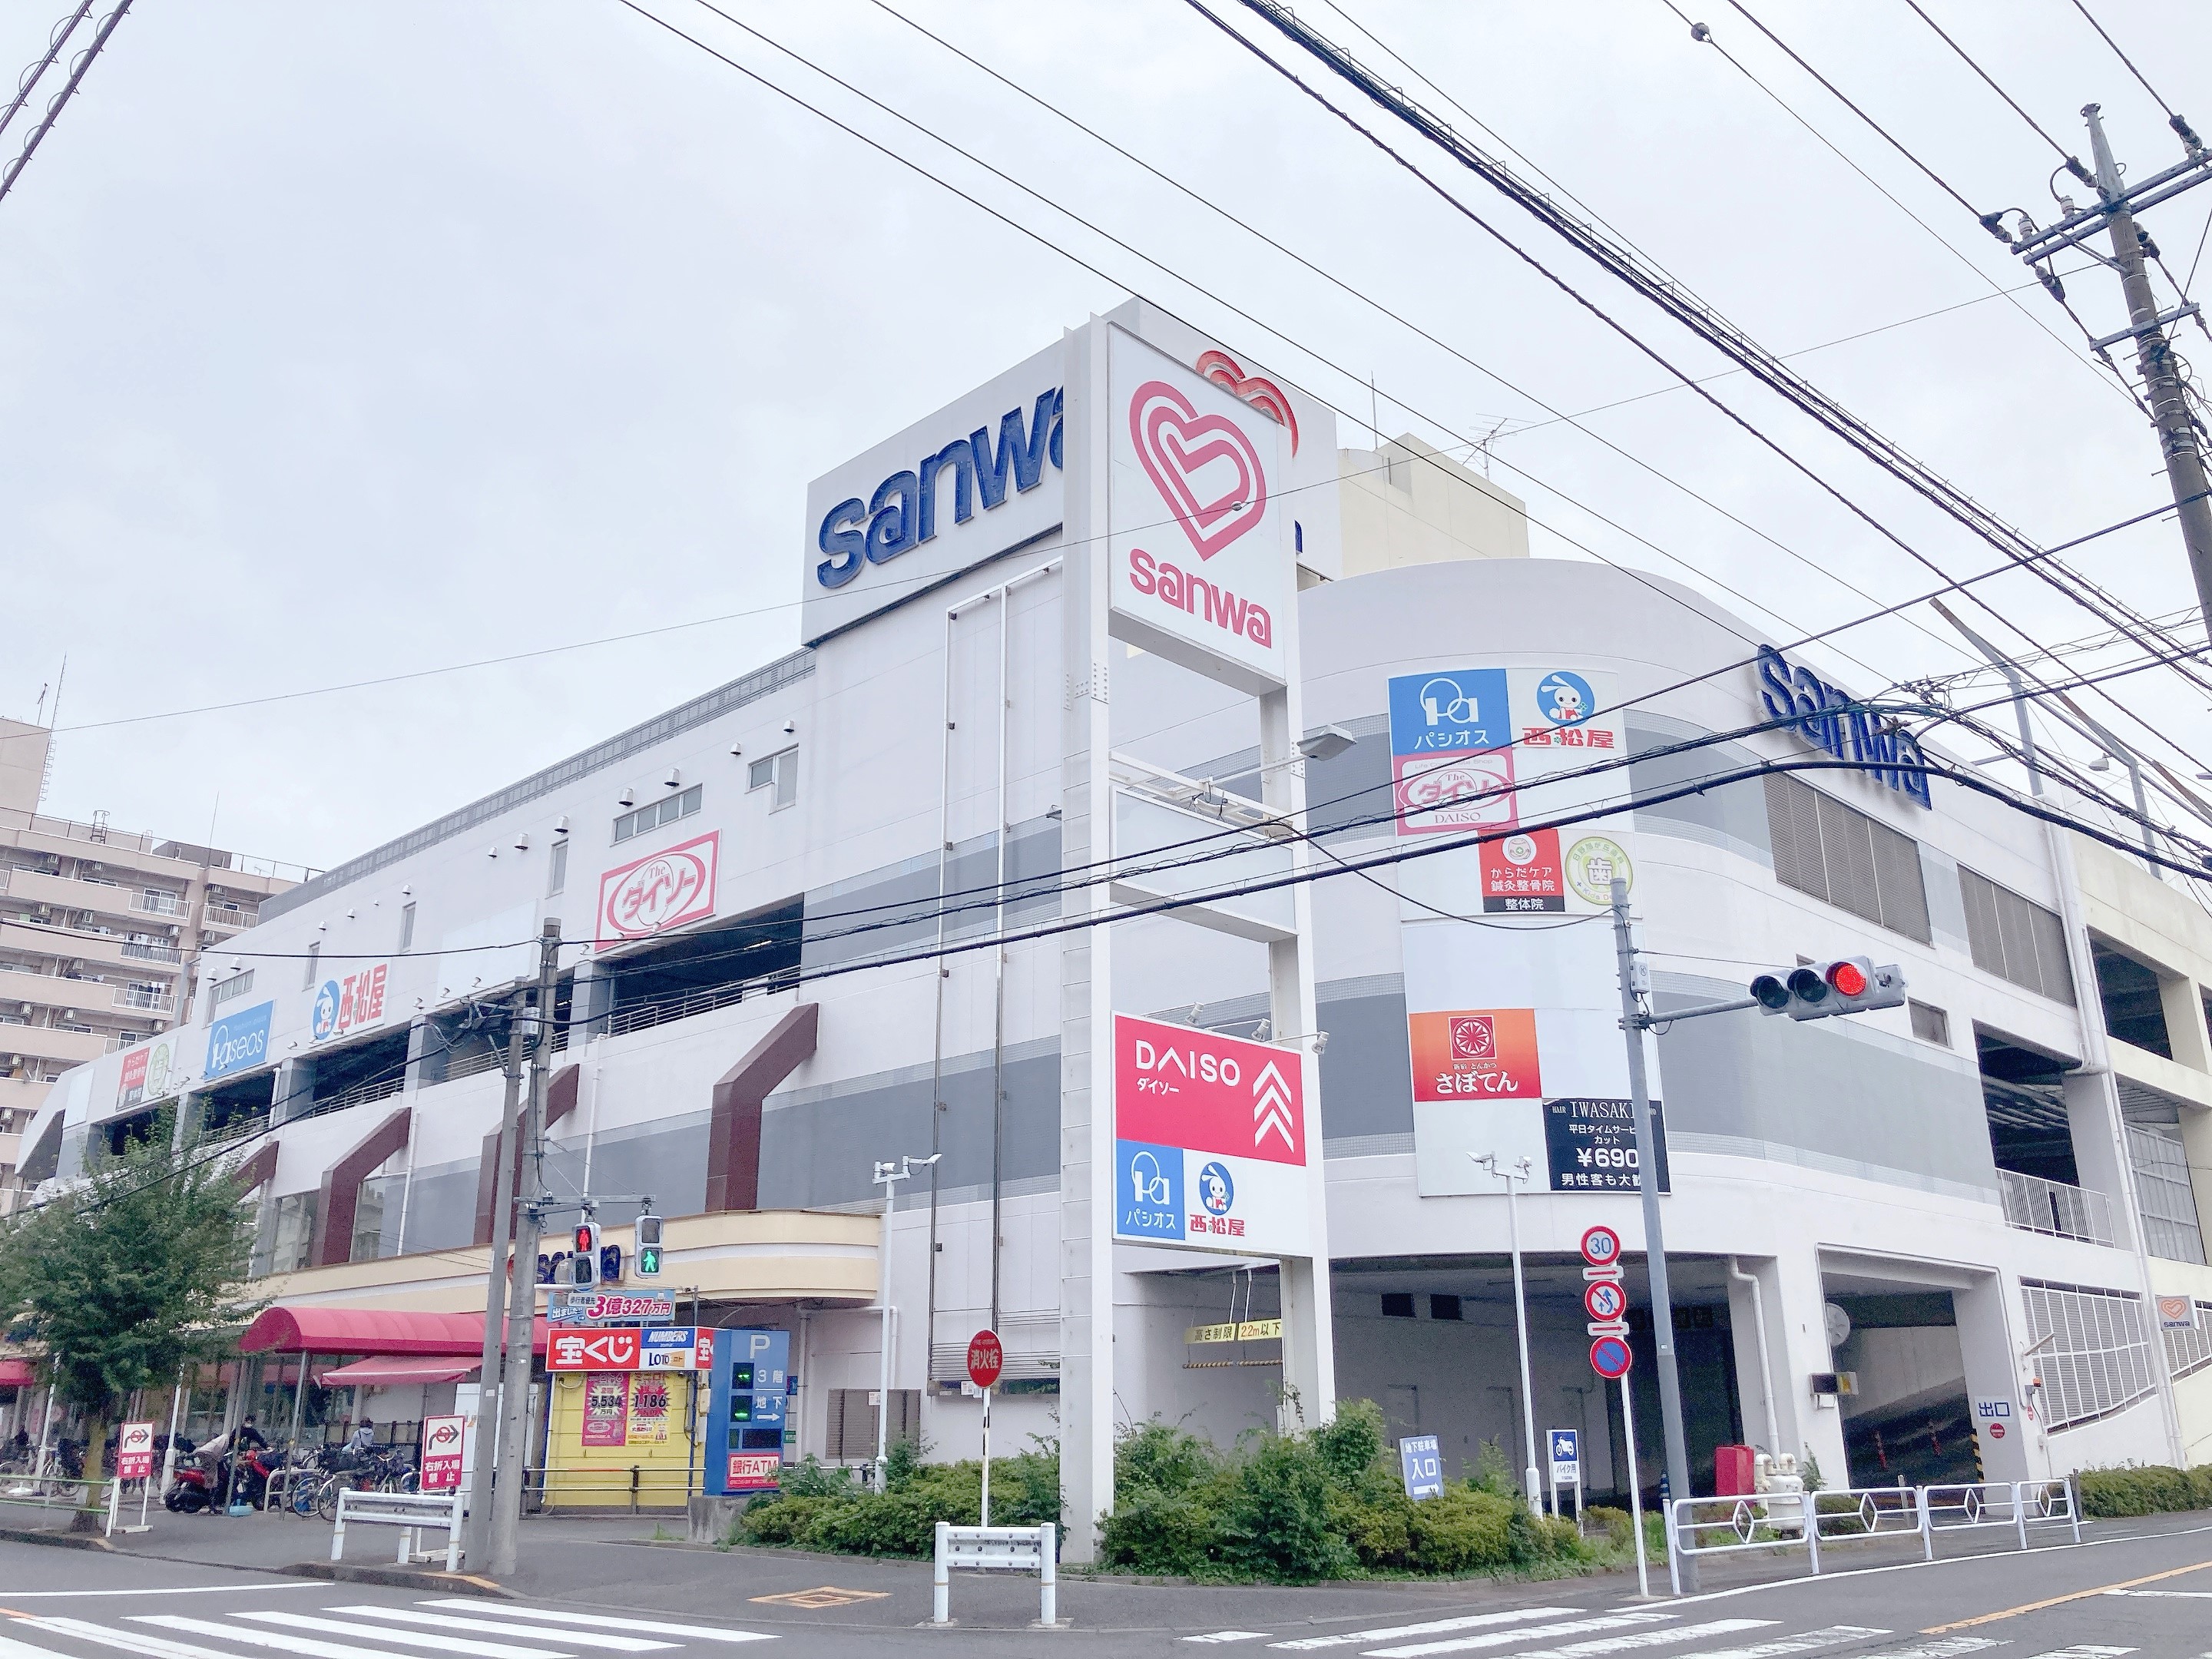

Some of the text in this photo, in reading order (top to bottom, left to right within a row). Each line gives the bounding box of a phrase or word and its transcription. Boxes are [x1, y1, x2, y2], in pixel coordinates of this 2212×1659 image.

[816, 385, 1063, 589] sanw
[1129, 548, 1272, 649] sanwa
[1414, 729, 1489, 750] パシオス
[1522, 727, 1614, 749] 西松屋
[1435, 813, 1482, 824] DAISO
[648, 866, 666, 879] The
[1491, 867, 1552, 879] からだケア
[1490, 879, 1555, 892] 鍼灸整骨院
[1505, 898, 1545, 911] 整体院
[339, 963, 387, 1030] 西松屋
[1135, 1039, 1241, 1087] DAISO
[1137, 1076, 1181, 1096] ダイソー
[1435, 1070, 1518, 1094] さぼてん
[1594, 1135, 1621, 1145] カット
[1125, 1208, 1176, 1230] パシオス
[1190, 1214, 1245, 1237] 西松屋
[1591, 1237, 1612, 1254] 30
[1194, 1326, 1233, 1341] 高さ制限
[555, 1336, 634, 1365] 宝くじ
[698, 1337, 714, 1361] 宝
[750, 1334, 770, 1359] P
[970, 1348, 999, 1369] 消火栓
[755, 1396, 783, 1409] 地下
[1979, 1402, 2011, 1417] 出口
[1411, 1458, 1437, 1481] 入口
[1556, 1463, 1577, 1474] バイク用
